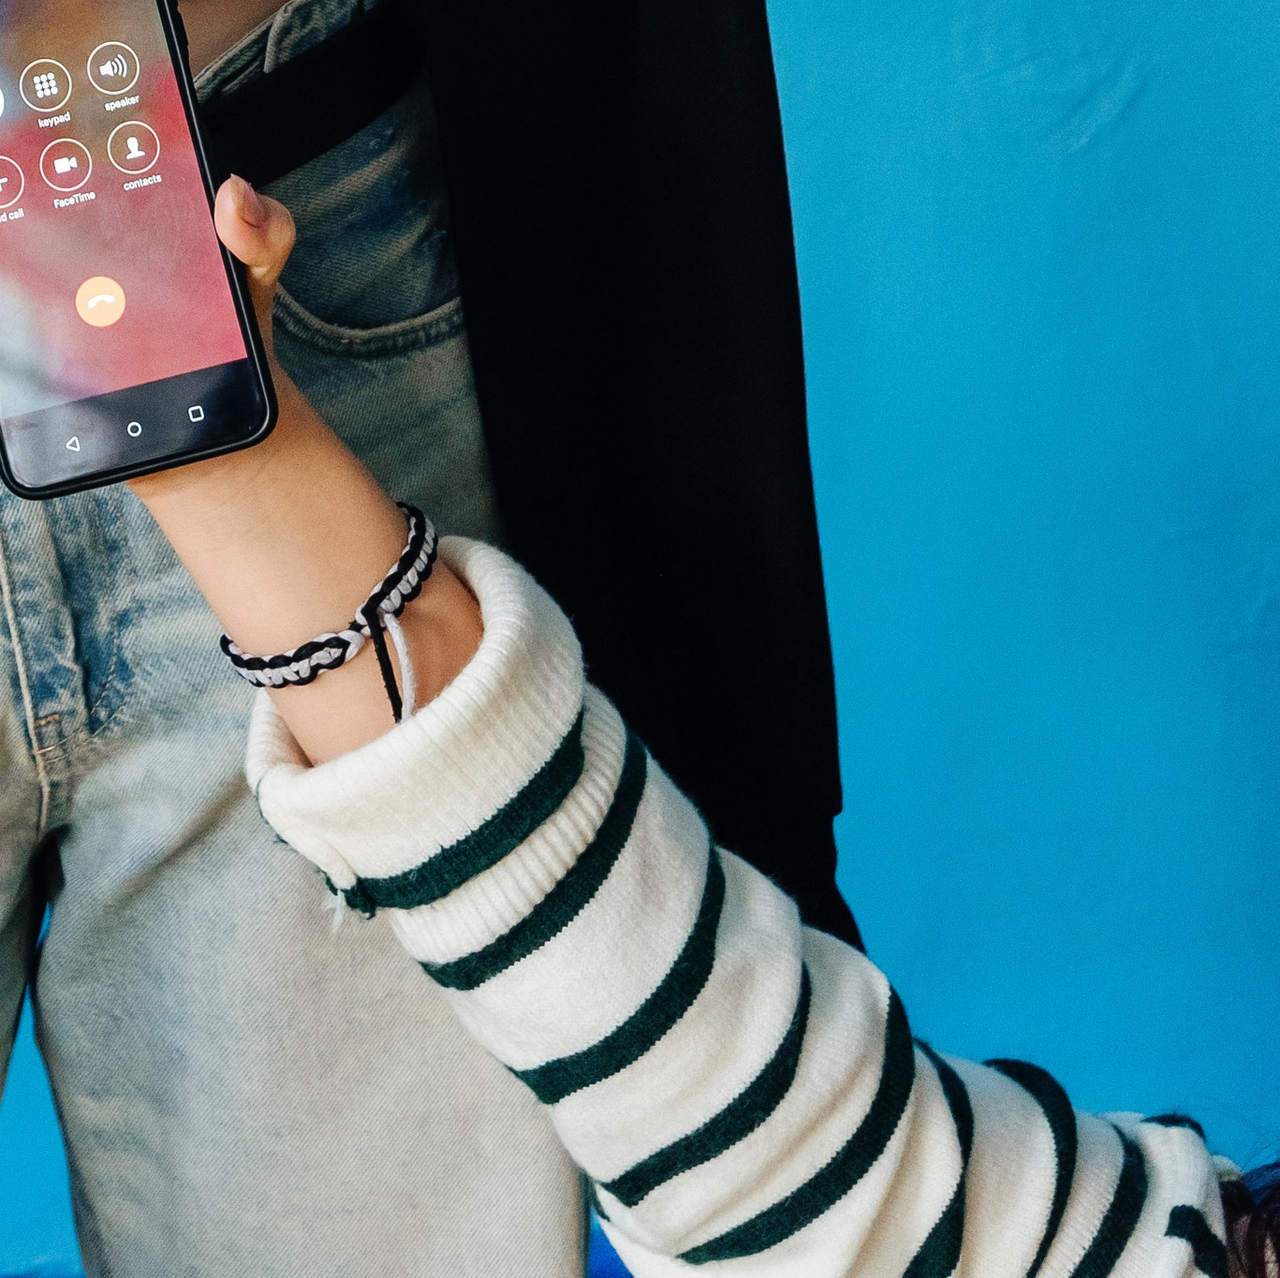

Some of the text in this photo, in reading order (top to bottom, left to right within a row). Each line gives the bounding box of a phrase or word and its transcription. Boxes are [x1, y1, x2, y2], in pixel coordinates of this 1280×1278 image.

[104, 94, 140, 112] speaker
[38, 111, 71, 128] keypad
[123, 174, 162, 191] contacts
[53, 191, 96, 209] FaceTime
[8, 208, 24, 221] call
